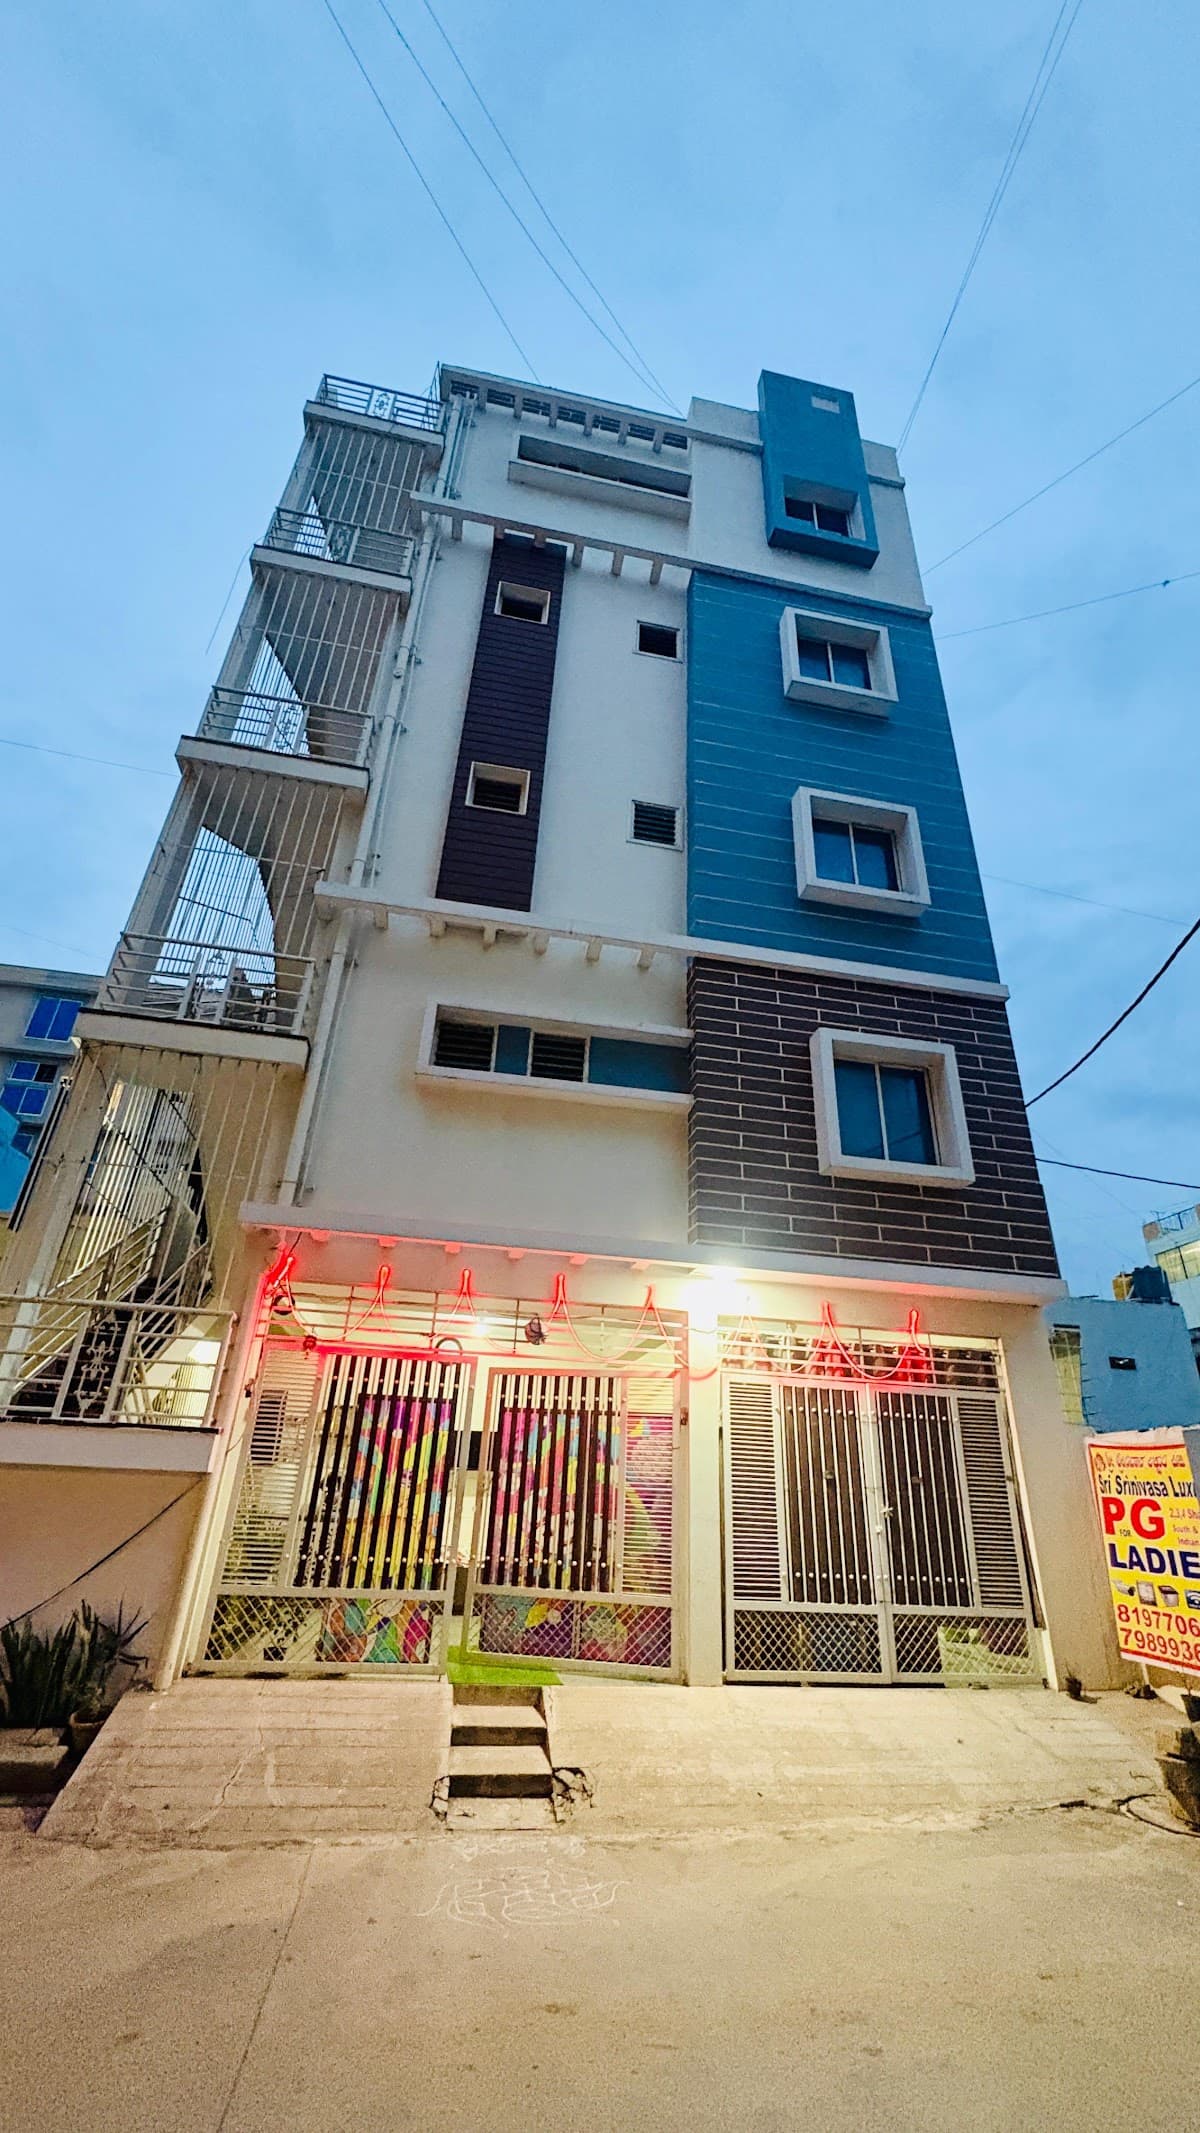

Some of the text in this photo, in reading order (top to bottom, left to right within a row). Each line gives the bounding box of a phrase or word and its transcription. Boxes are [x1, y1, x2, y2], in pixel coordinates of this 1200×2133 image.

[1098, 1474, 1111, 1494] Sri
[1115, 1475, 1168, 1497] Srinivasa
[1101, 1496, 1165, 1541] PG
[1108, 1543, 1200, 1579] LADIE
[1117, 1604, 1200, 1637] 8197706
